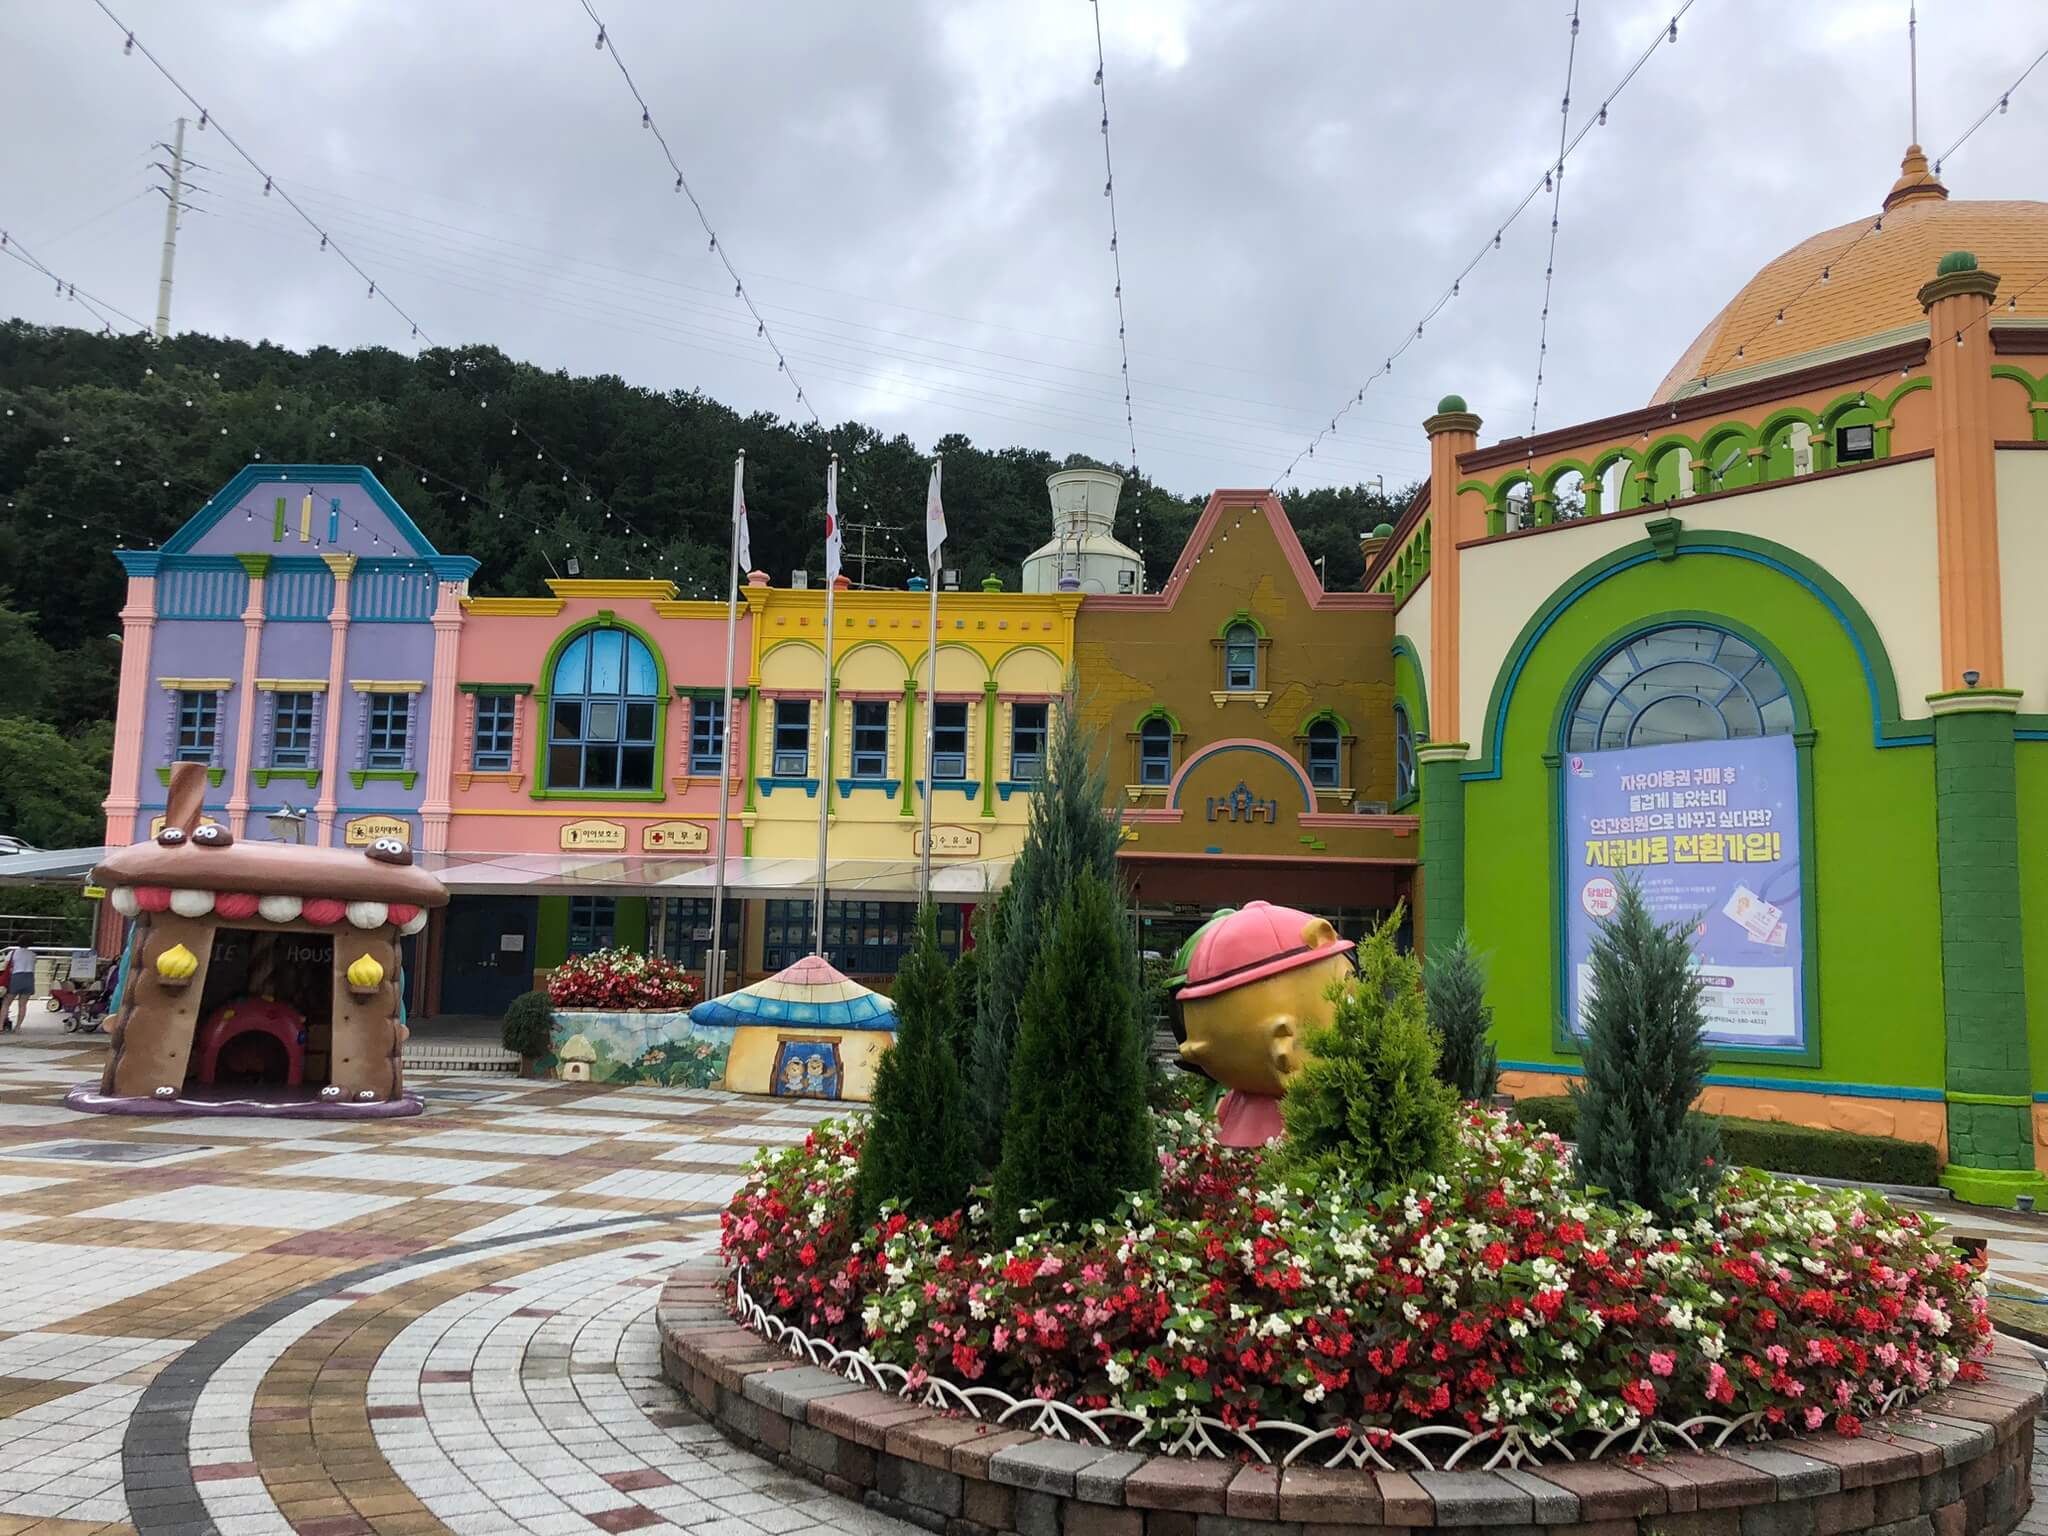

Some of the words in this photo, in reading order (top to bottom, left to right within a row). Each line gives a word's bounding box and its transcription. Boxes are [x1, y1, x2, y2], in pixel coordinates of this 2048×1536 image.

[1620, 769, 1690, 791] 자유이용권
[1693, 767, 1721, 786] 구매
[1723, 766, 1736, 785] 후
[1630, 791, 1670, 812] 즐겁게
[1672, 789, 1727, 809] 놀았는데
[1590, 813, 1675, 835] 연간회원으로
[1677, 810, 1717, 829] 바꾸고
[1719, 809, 1773, 828] 싶다면?
[1584, 836, 1669, 867] 지금바로
[1673, 832, 1781, 864] 전환가입!
[287, 944, 332, 962] HOUS
